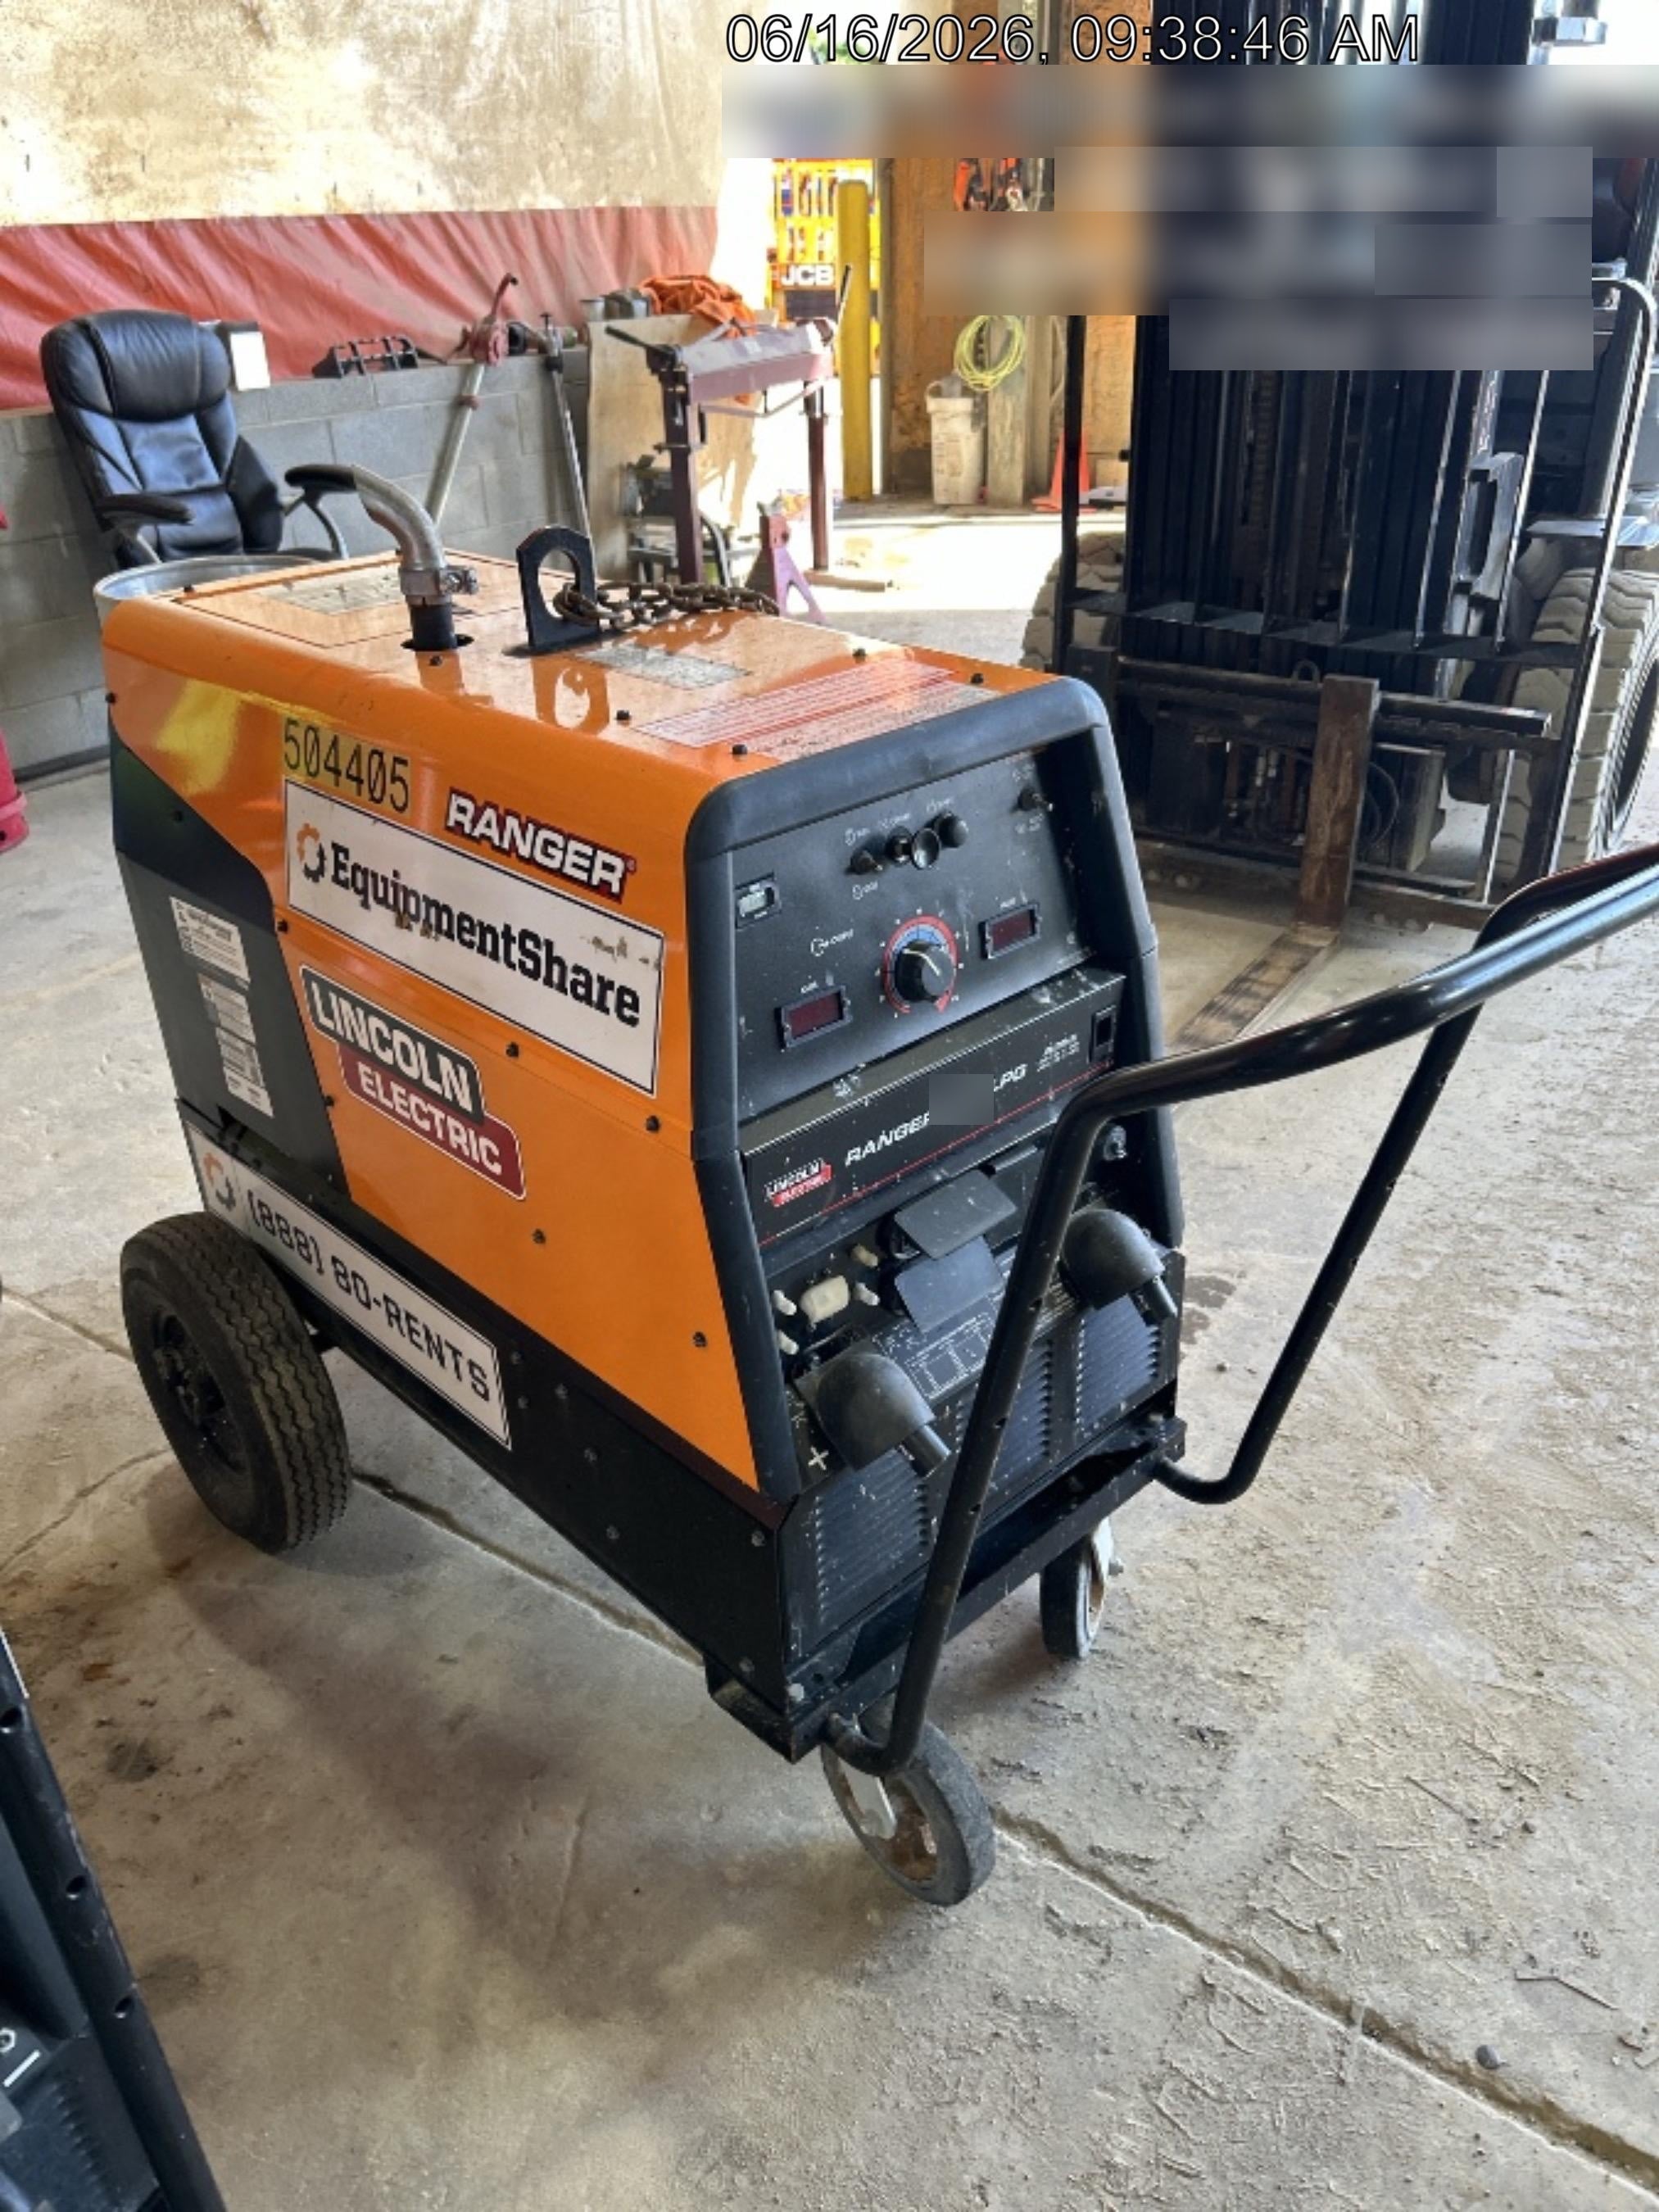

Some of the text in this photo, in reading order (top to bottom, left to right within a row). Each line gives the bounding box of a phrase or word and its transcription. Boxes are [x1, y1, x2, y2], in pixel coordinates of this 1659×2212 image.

[781, 264, 834, 285] JCB
[283, 719, 410, 813] 504405
[446, 793, 627, 894] RANGER
[331, 841, 641, 1028] EquipmentShare
[310, 981, 474, 1113] LINCOLN
[358, 1062, 502, 1176] ELECTRIC
[247, 1189, 490, 1402] (888) 80-RENTS
